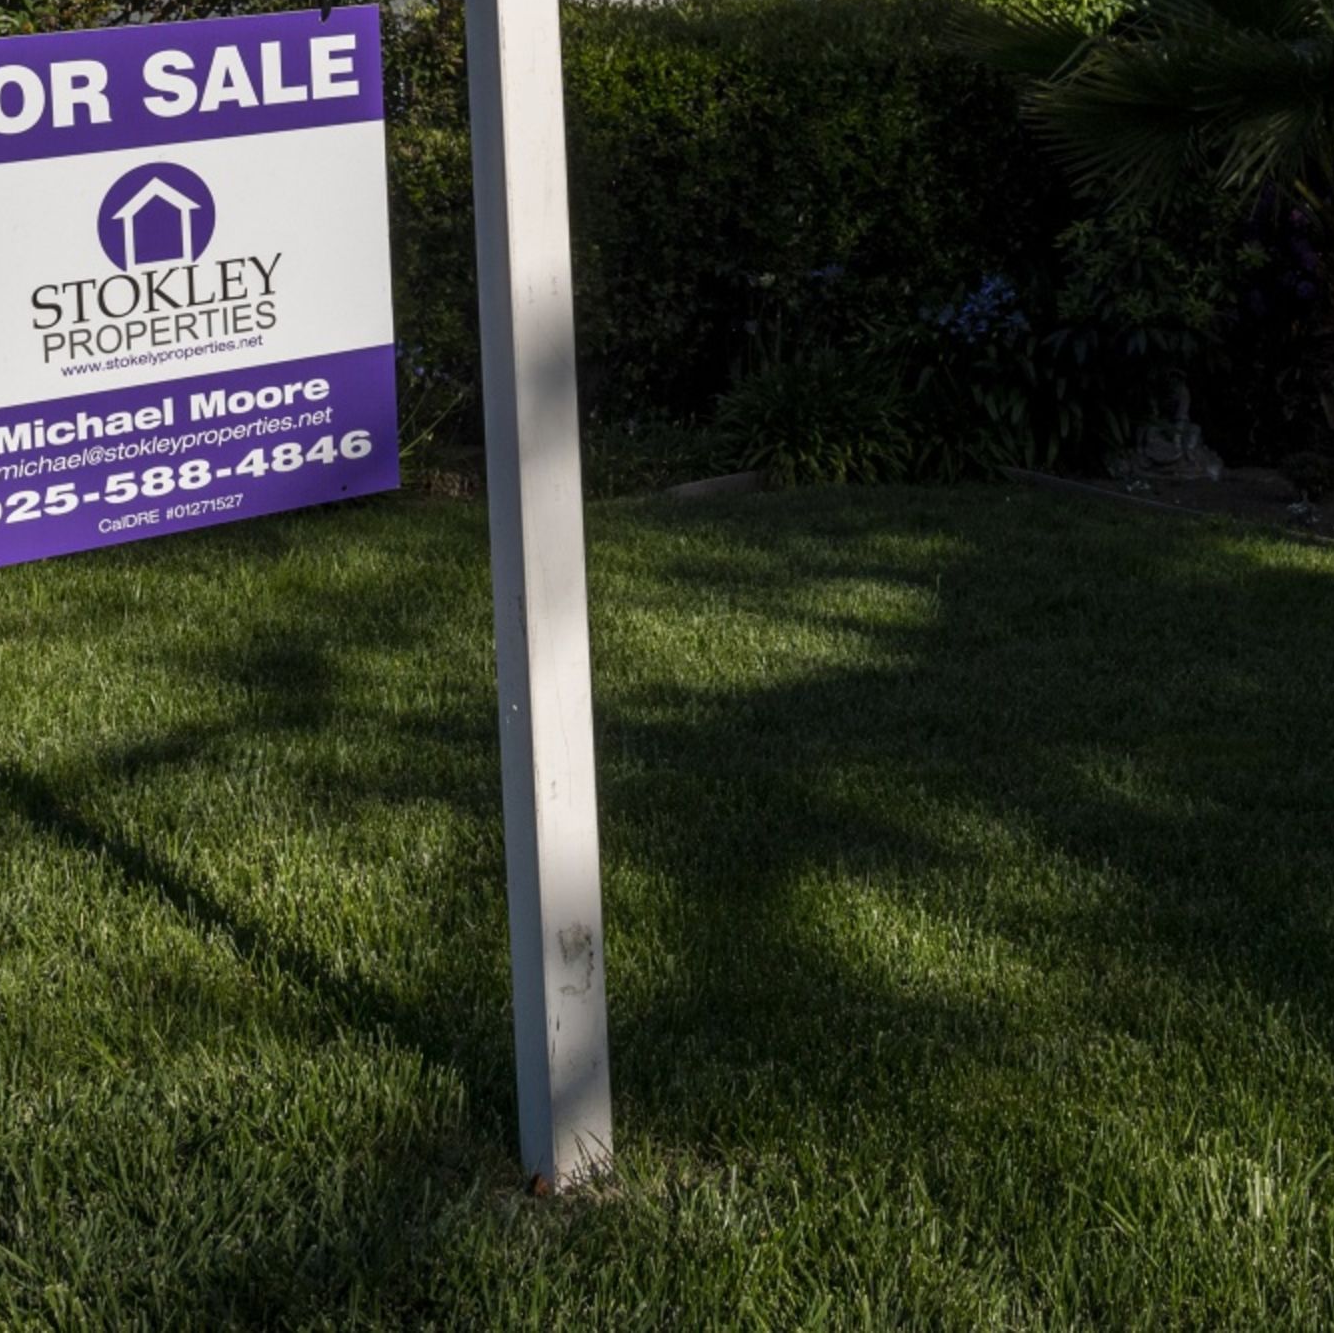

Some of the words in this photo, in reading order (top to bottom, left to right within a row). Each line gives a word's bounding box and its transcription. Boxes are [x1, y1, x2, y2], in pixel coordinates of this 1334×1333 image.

[142, 34, 360, 118] SALE
[31, 253, 282, 330] STOKLEY
[43, 301, 277, 364] PROPERTIES
[189, 378, 330, 421] Moore
[98, 509, 160, 534] CalDRE
[166, 493, 244, 520] #01271527
